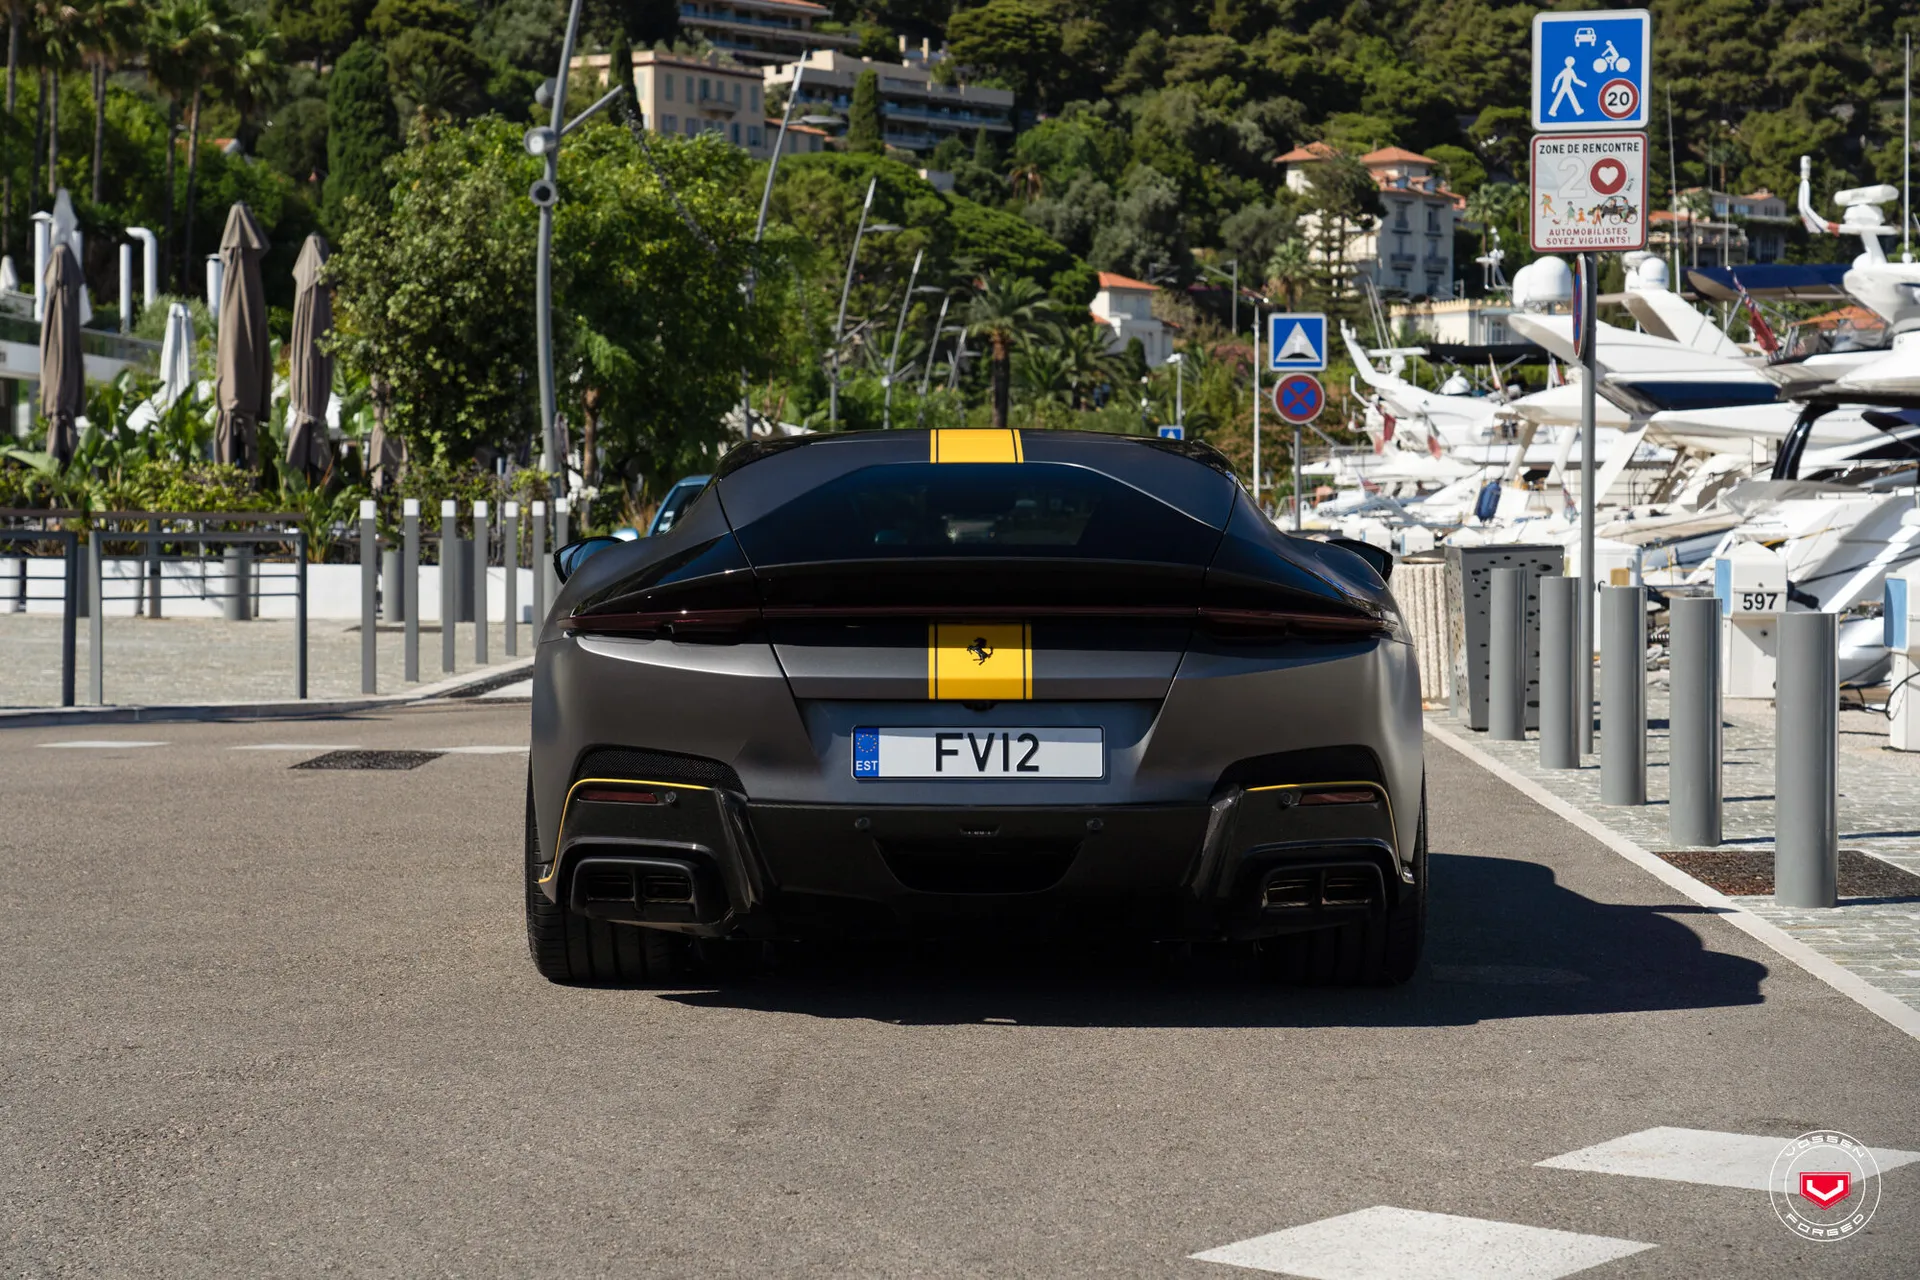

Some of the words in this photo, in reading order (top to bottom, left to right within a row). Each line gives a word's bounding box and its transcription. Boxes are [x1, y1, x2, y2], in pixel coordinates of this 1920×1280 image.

[1608, 91, 1630, 106] 20
[1539, 144, 1564, 155] ZONE
[1567, 144, 1579, 154] DE
[1582, 142, 1640, 153] RENCONTRE
[1549, 227, 1628, 236] AUTOMOBILISTES
[1546, 237, 1575, 245] SOYEZ
[1743, 593, 1778, 610] 597
[856, 760, 878, 771] EST
